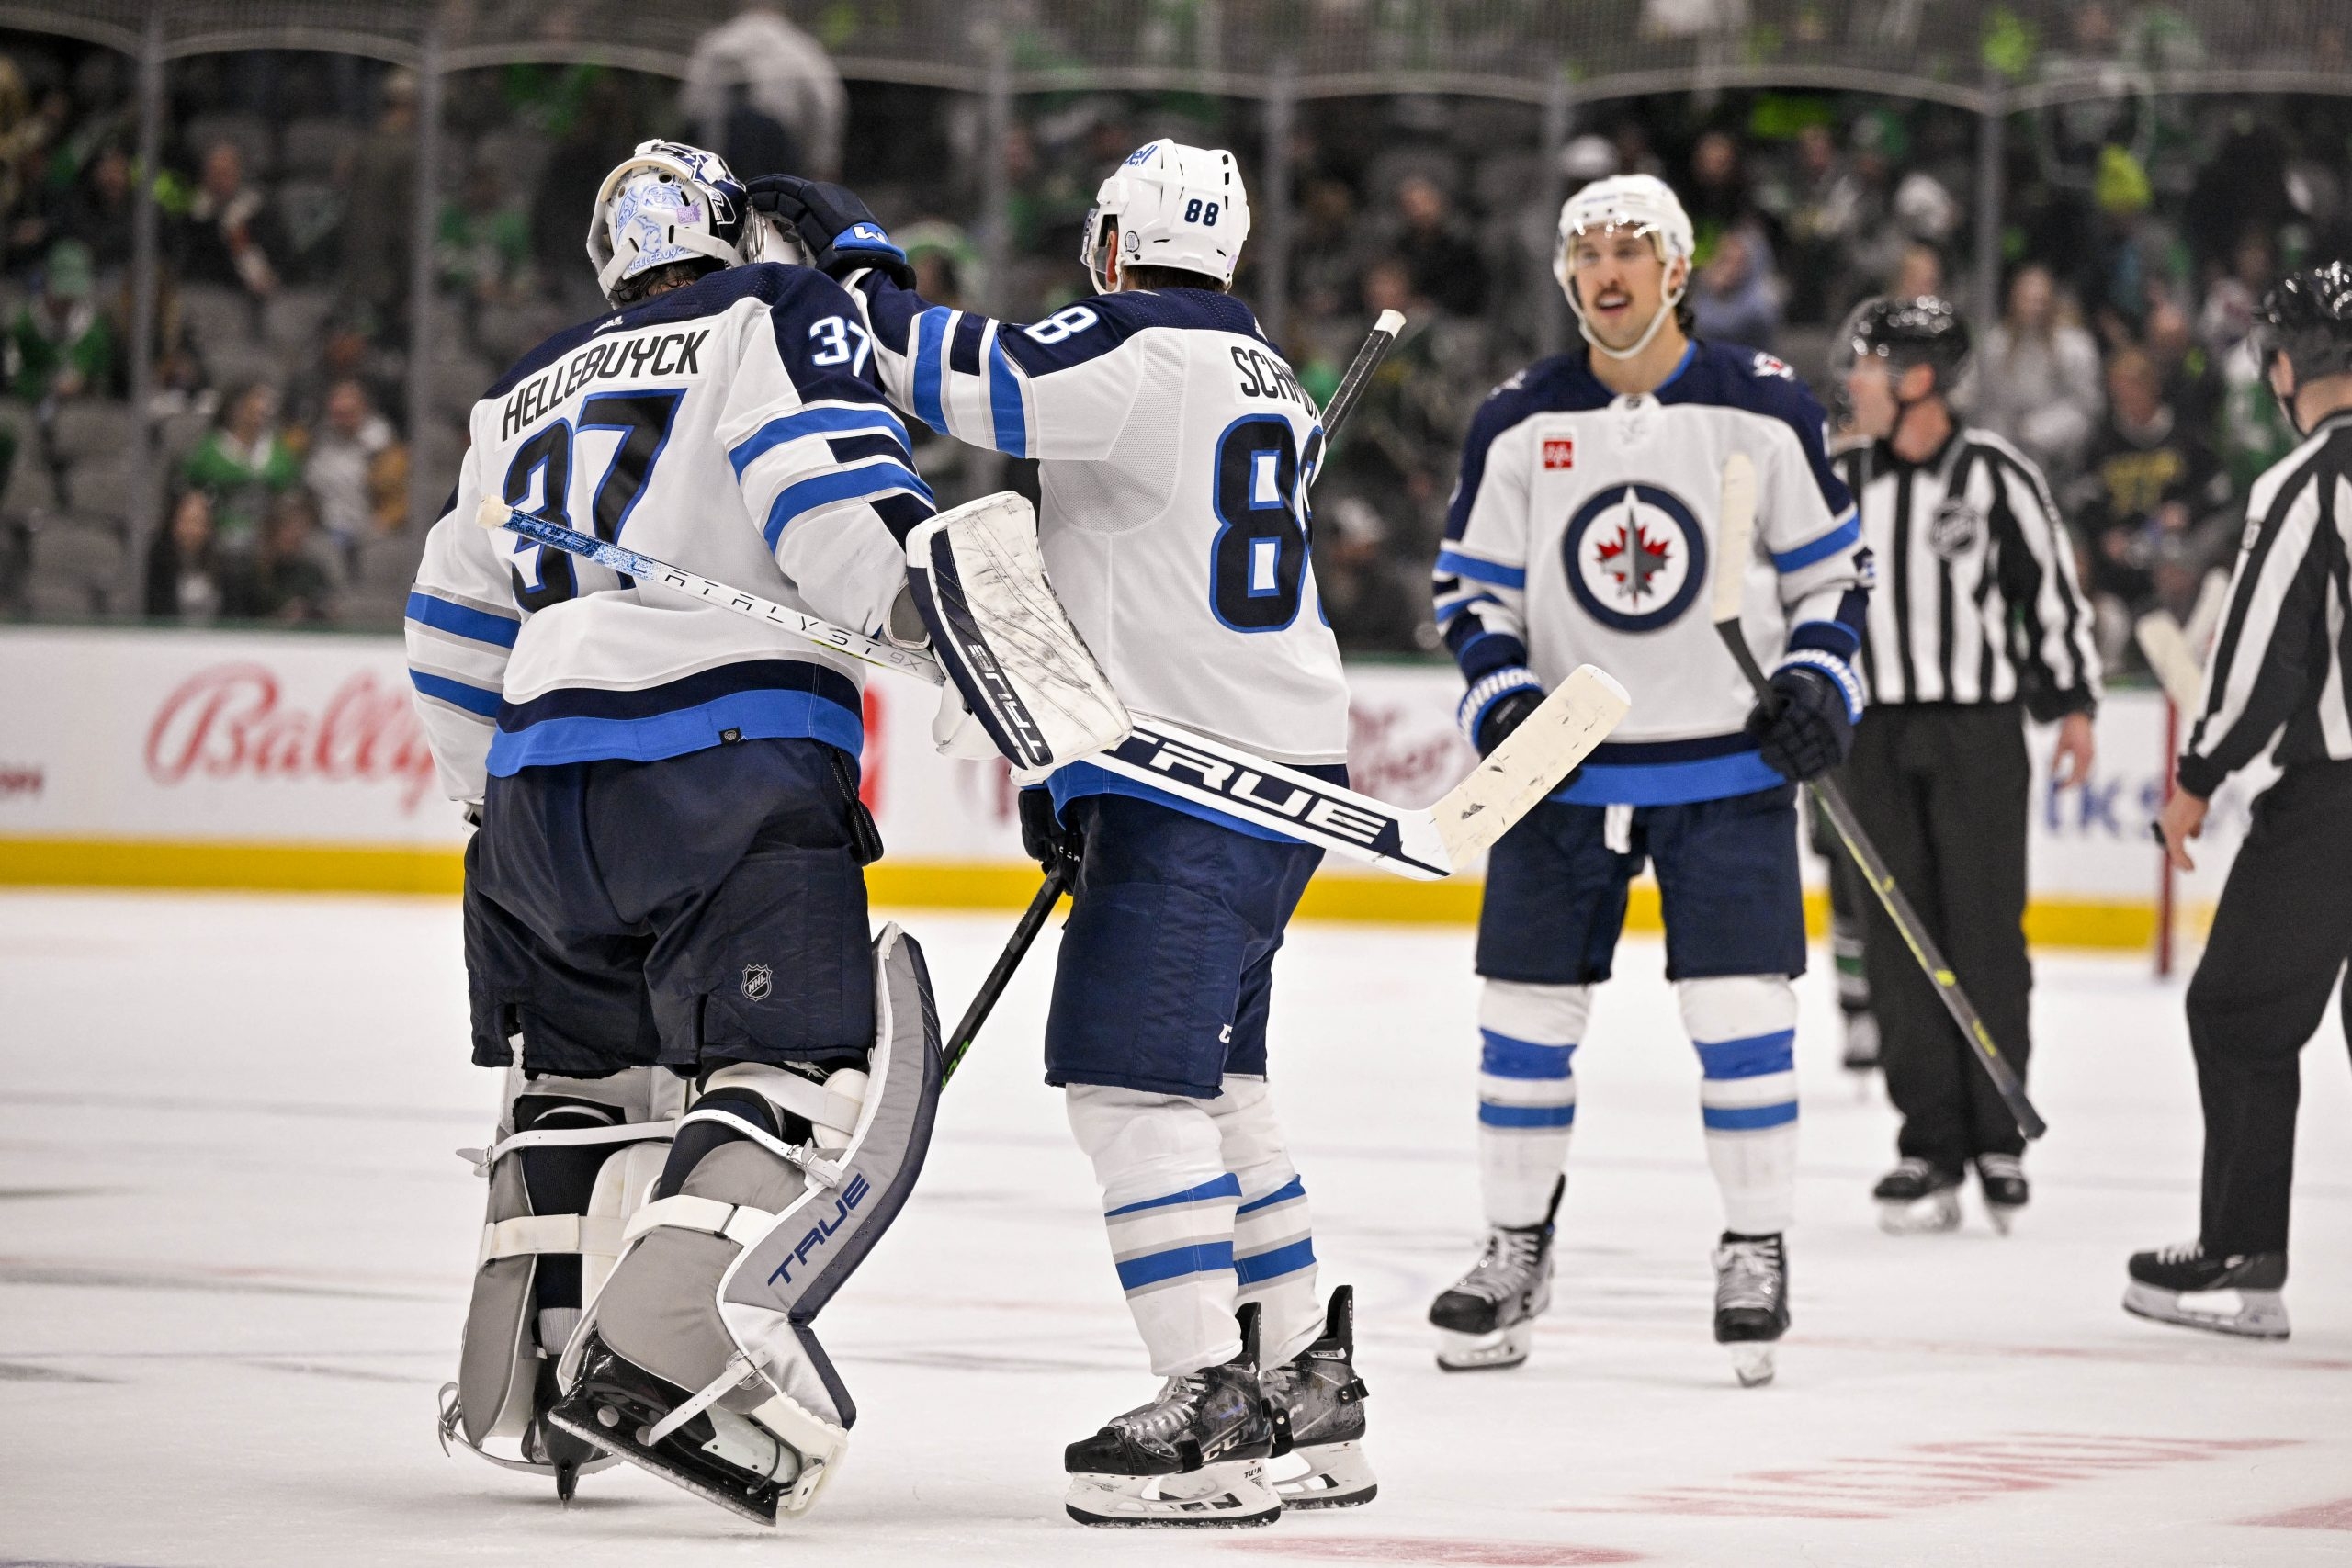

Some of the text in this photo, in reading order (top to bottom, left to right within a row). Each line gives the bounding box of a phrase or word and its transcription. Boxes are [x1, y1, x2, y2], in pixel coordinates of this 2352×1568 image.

[1184, 198, 1220, 227] 88
[502, 329, 711, 443] HELLEBUYCK
[808, 316, 872, 378] 37
[502, 388, 689, 614] 37
[630, 556, 923, 671] CATALYST 9X
[145, 661, 437, 818] Bally
[967, 644, 1043, 762] TRUE
[747, 974, 766, 994] NHL
[768, 1172, 871, 1287] TRUE
[1202, 1417, 1258, 1463] CCM
